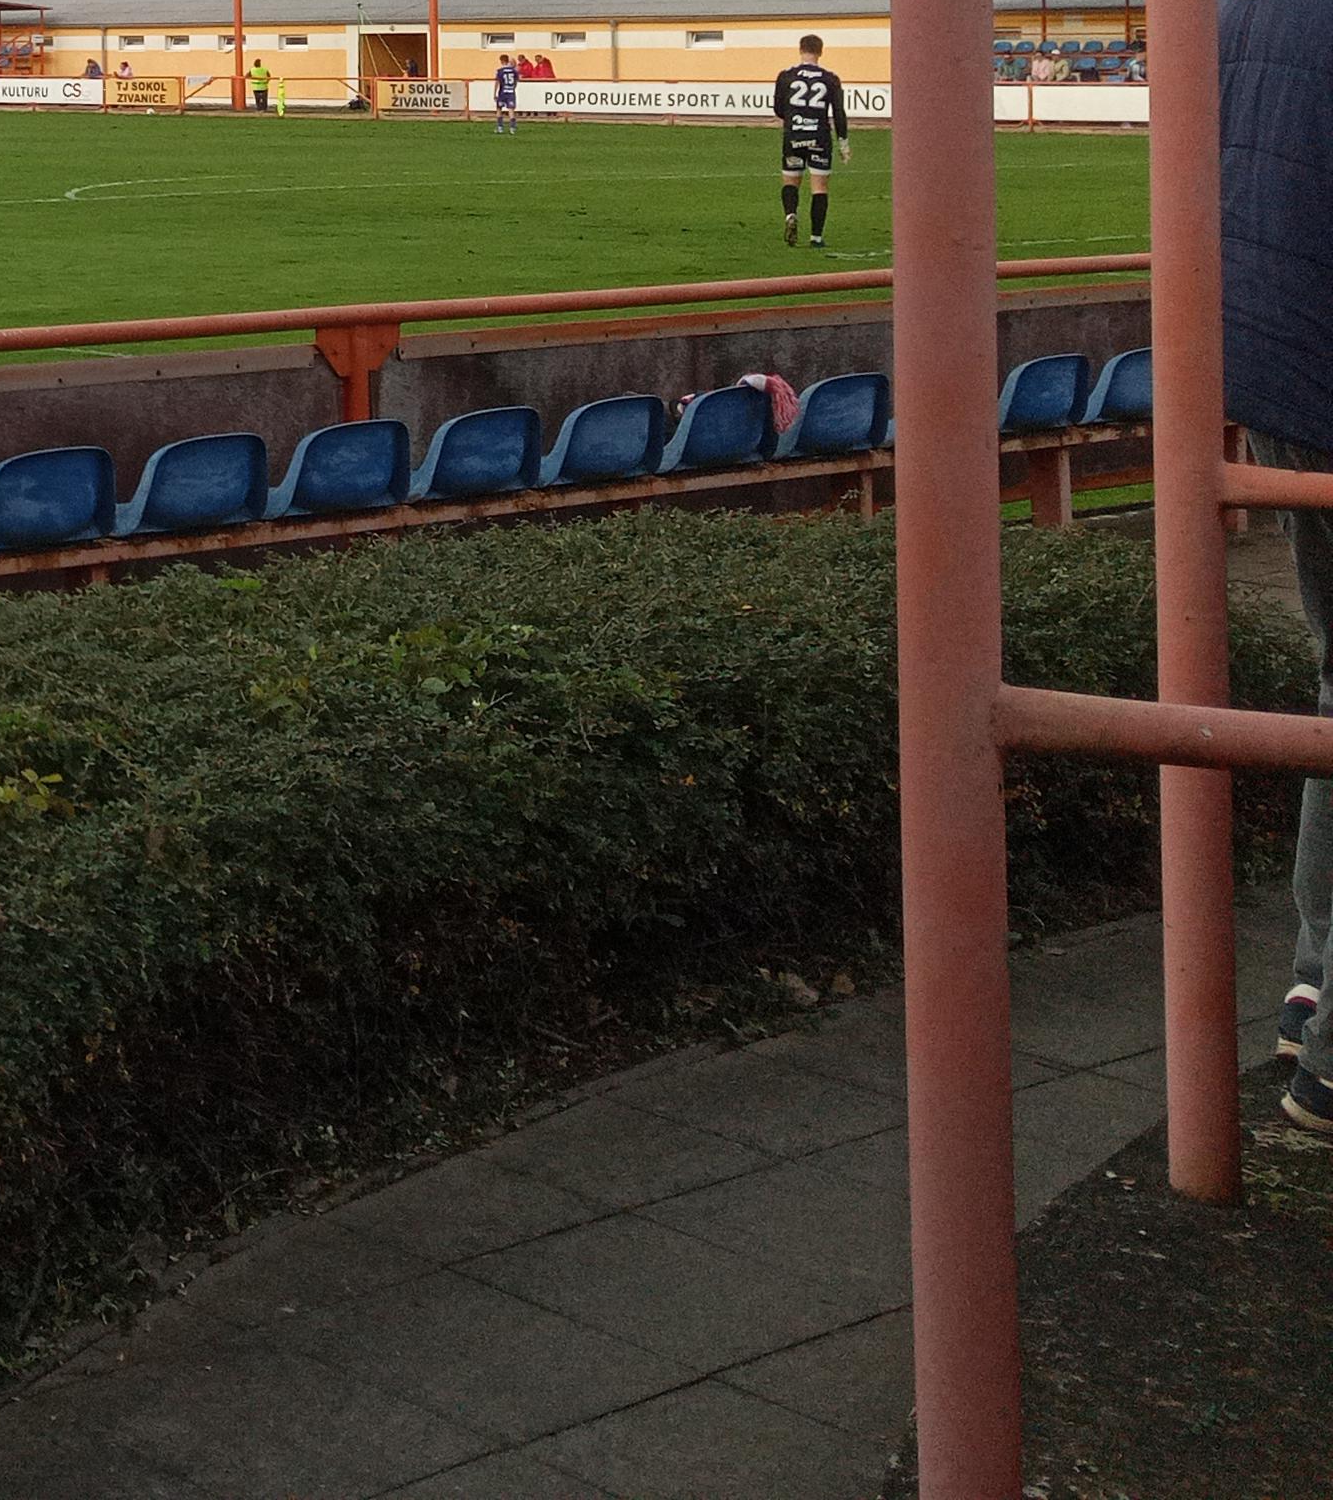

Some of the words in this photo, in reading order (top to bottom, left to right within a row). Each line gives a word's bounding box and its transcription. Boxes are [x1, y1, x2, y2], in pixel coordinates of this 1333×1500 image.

[502, 72, 515, 85] 15
[2, 86, 49, 98] KULTURU
[116, 81, 129, 91] TJ
[131, 81, 167, 92] SOKOL
[389, 83, 405, 94] TJ
[408, 84, 452, 95] SOKOL
[544, 91, 663, 107] PODPORUJEME
[667, 93, 721, 108] SPORT
[724, 94, 736, 109] A
[789, 80, 828, 108] 22
